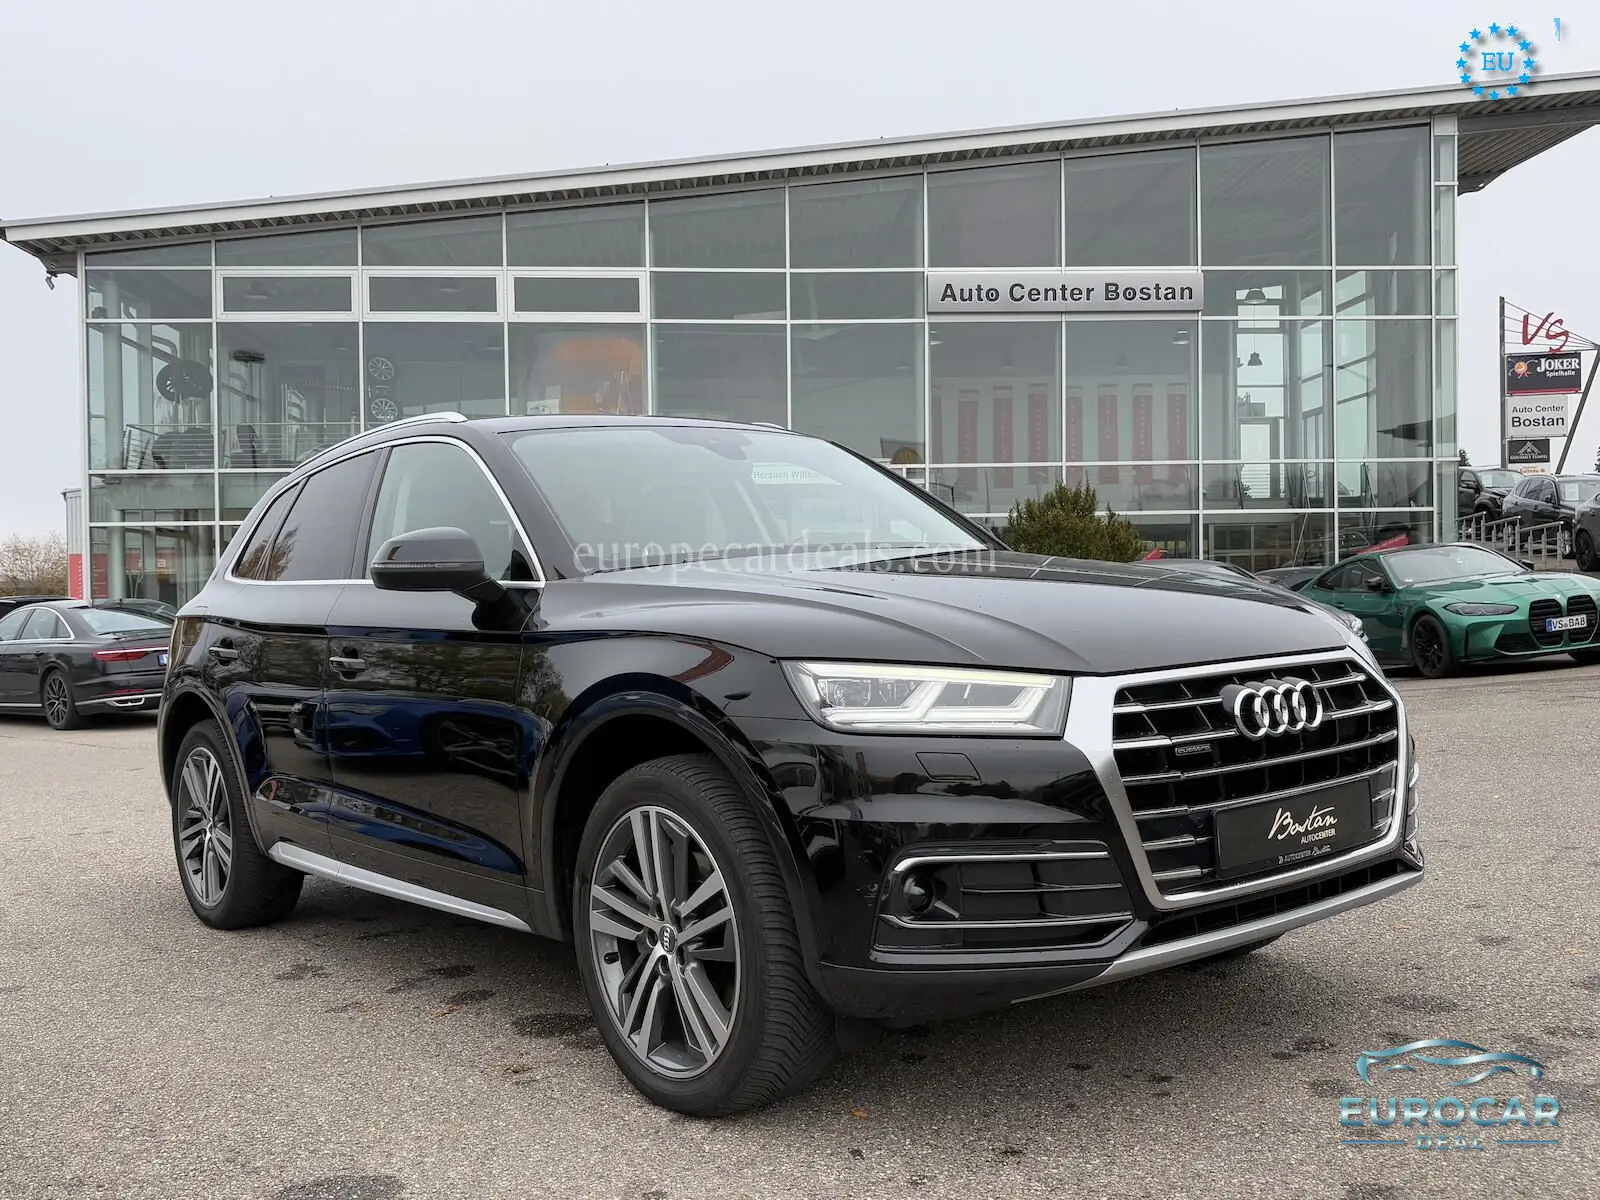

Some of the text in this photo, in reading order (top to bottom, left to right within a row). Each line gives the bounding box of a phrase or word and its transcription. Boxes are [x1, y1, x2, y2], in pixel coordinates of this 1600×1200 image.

[940, 282, 1193, 302] Auto Center Bostan
[1522, 312, 1569, 353] VS
[1536, 357, 1580, 372] JOKER
[1545, 370, 1576, 378] Spielhalle
[1535, 404, 1565, 413] Center
[1511, 415, 1565, 428] Bostan
[753, 470, 789, 480] Herzlich
[1552, 616, 1586, 629] VS BAB
[1267, 804, 1338, 840] Bostan
[1301, 828, 1336, 844] AUTOCENTER
